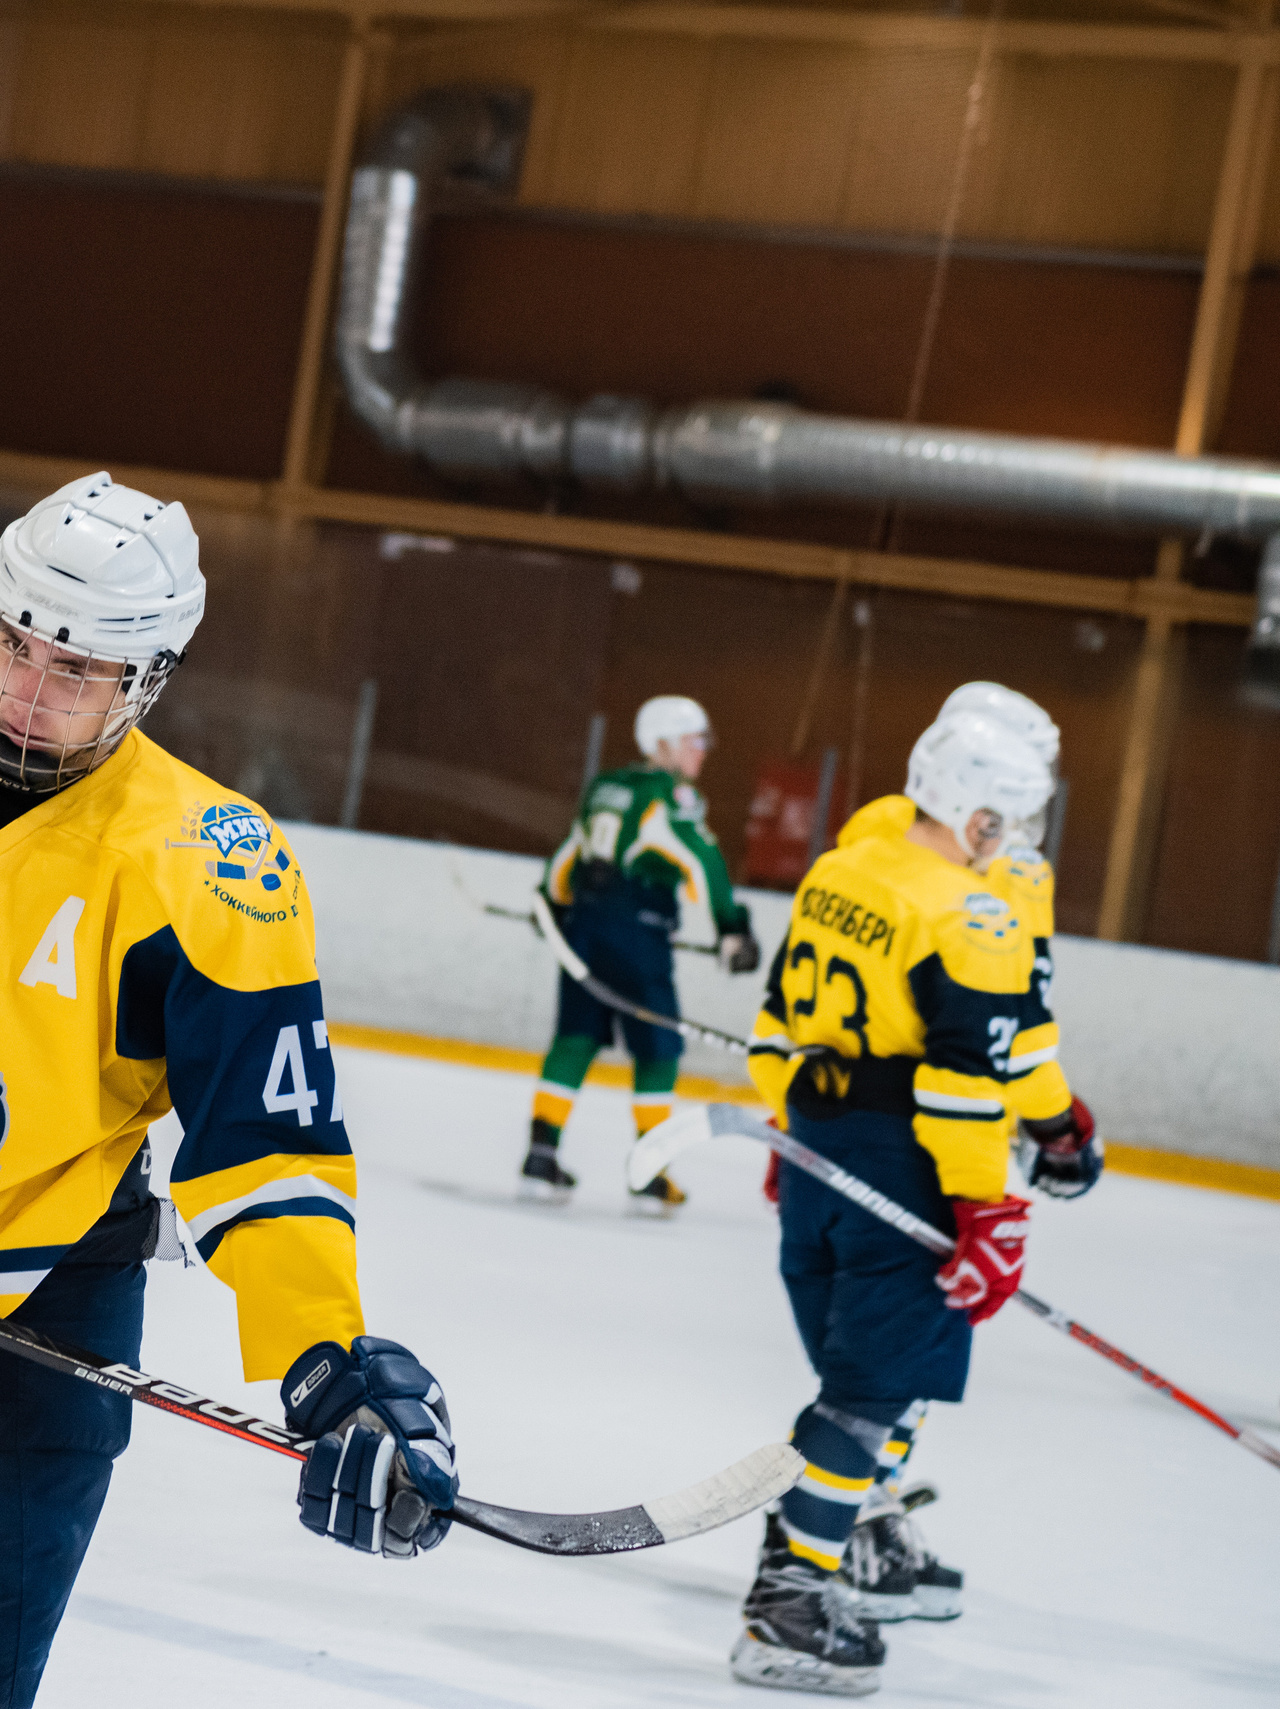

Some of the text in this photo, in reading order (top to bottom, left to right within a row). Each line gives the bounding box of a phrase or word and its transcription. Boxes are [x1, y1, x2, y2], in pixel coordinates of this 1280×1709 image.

[209, 817, 270, 851] МИР
[210, 884, 287, 923] ХОККЕЙНОГО
[18, 894, 86, 1000] A
[74, 1367, 134, 1396] BAUER
